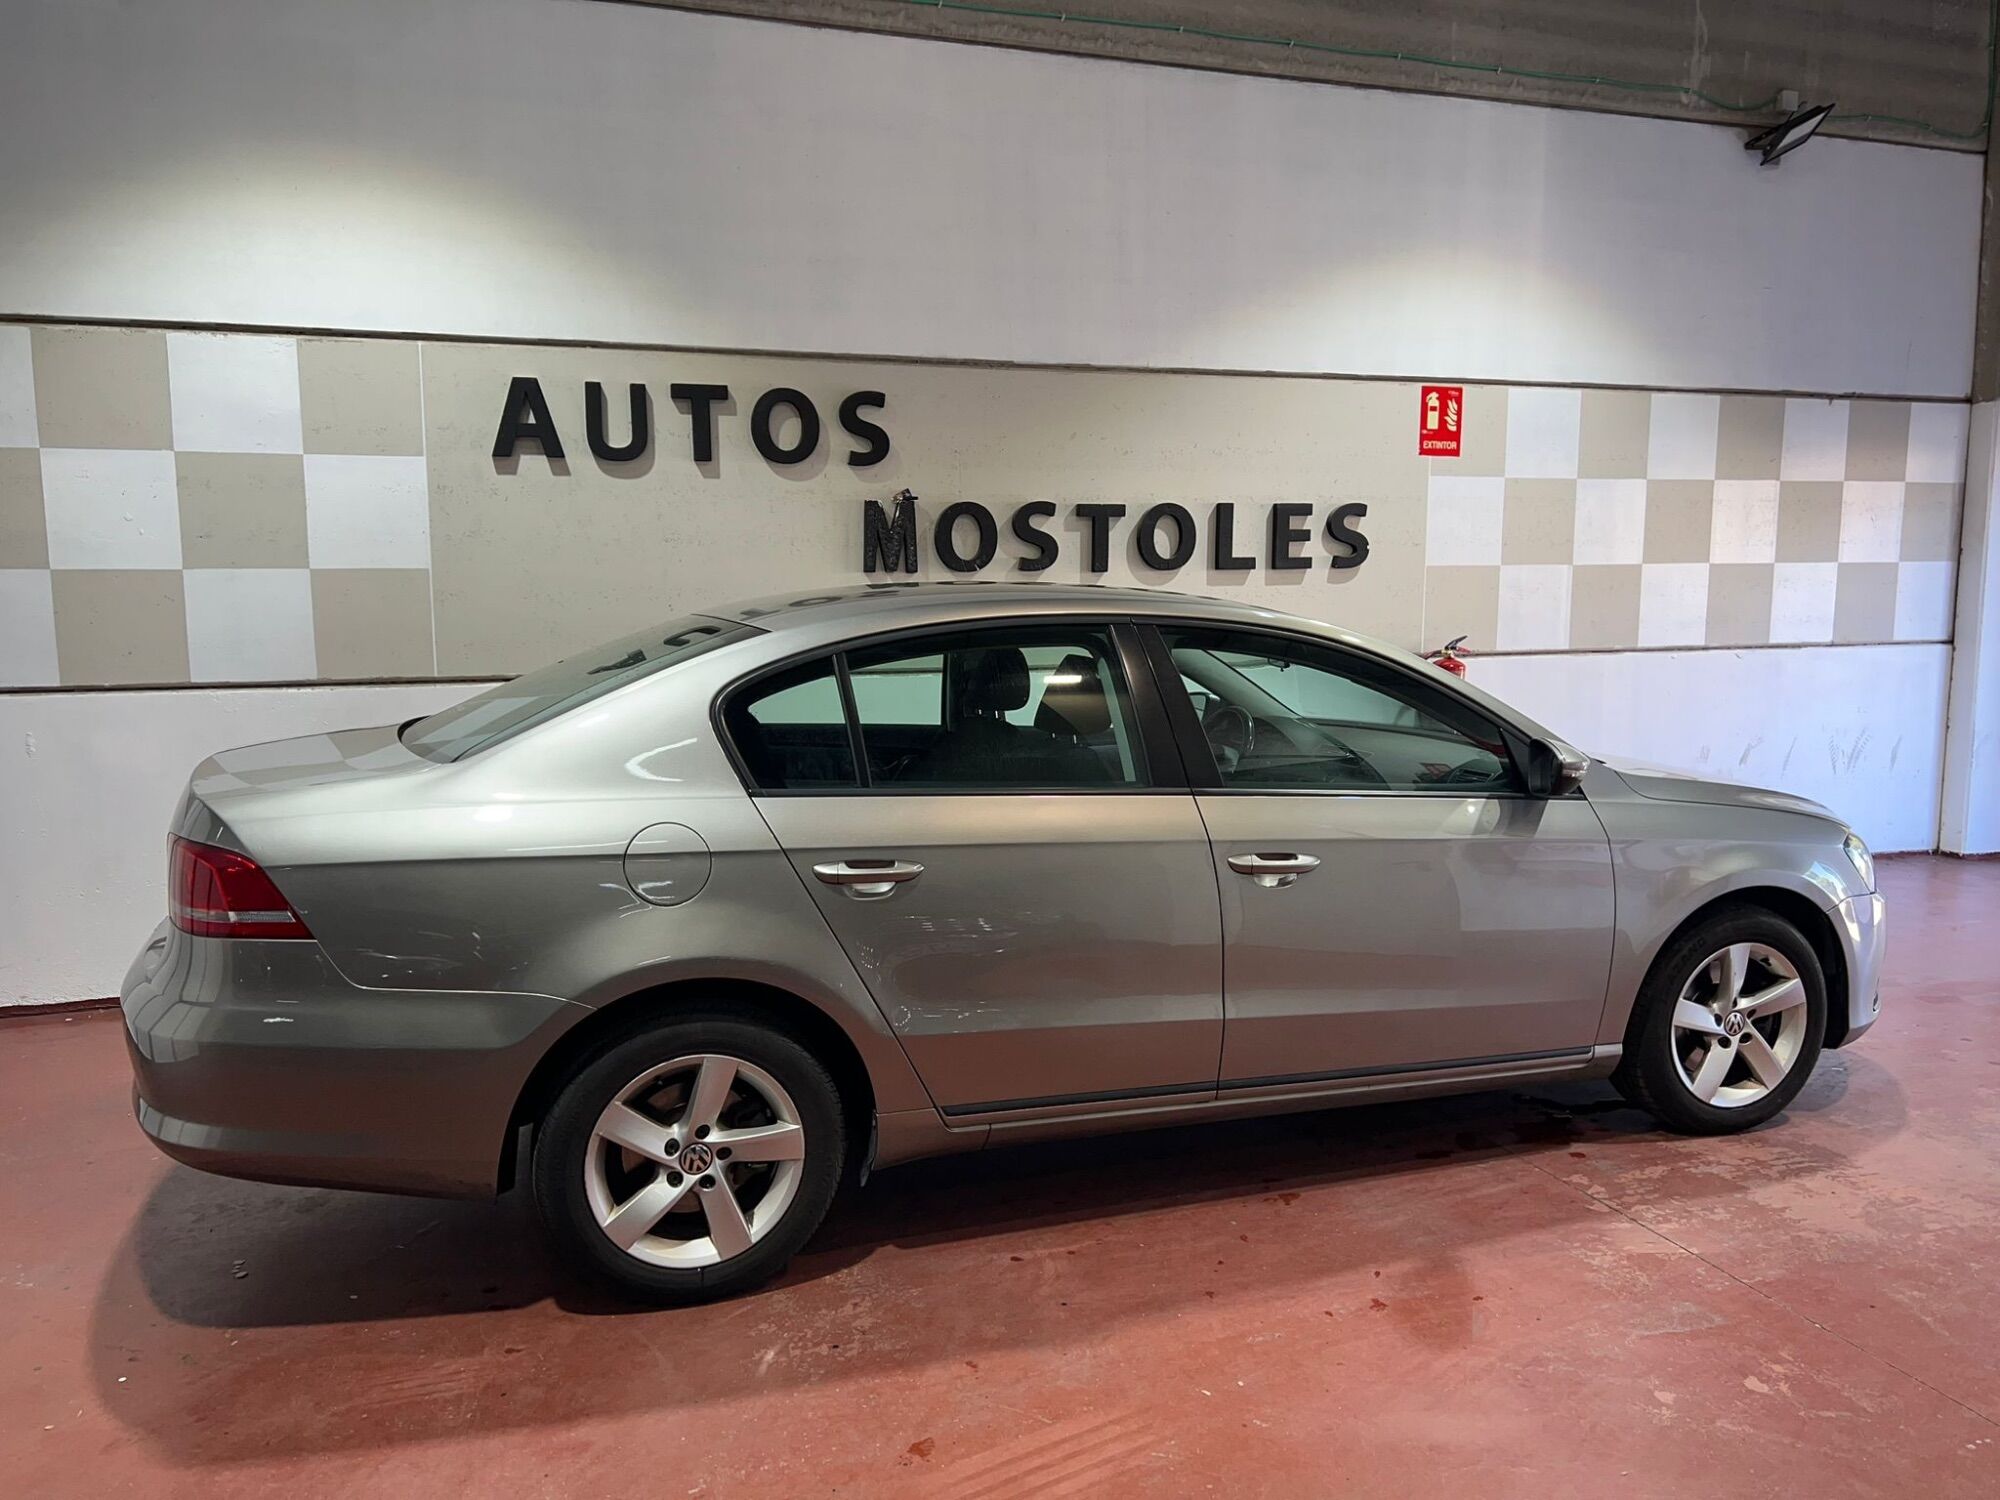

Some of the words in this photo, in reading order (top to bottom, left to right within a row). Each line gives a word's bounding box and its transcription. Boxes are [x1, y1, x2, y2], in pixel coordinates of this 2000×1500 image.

[491, 376, 891, 467] AUTOS
[1422, 440, 1458, 450] EXTINTOR
[863, 499, 1370, 574] MOSTOLES
